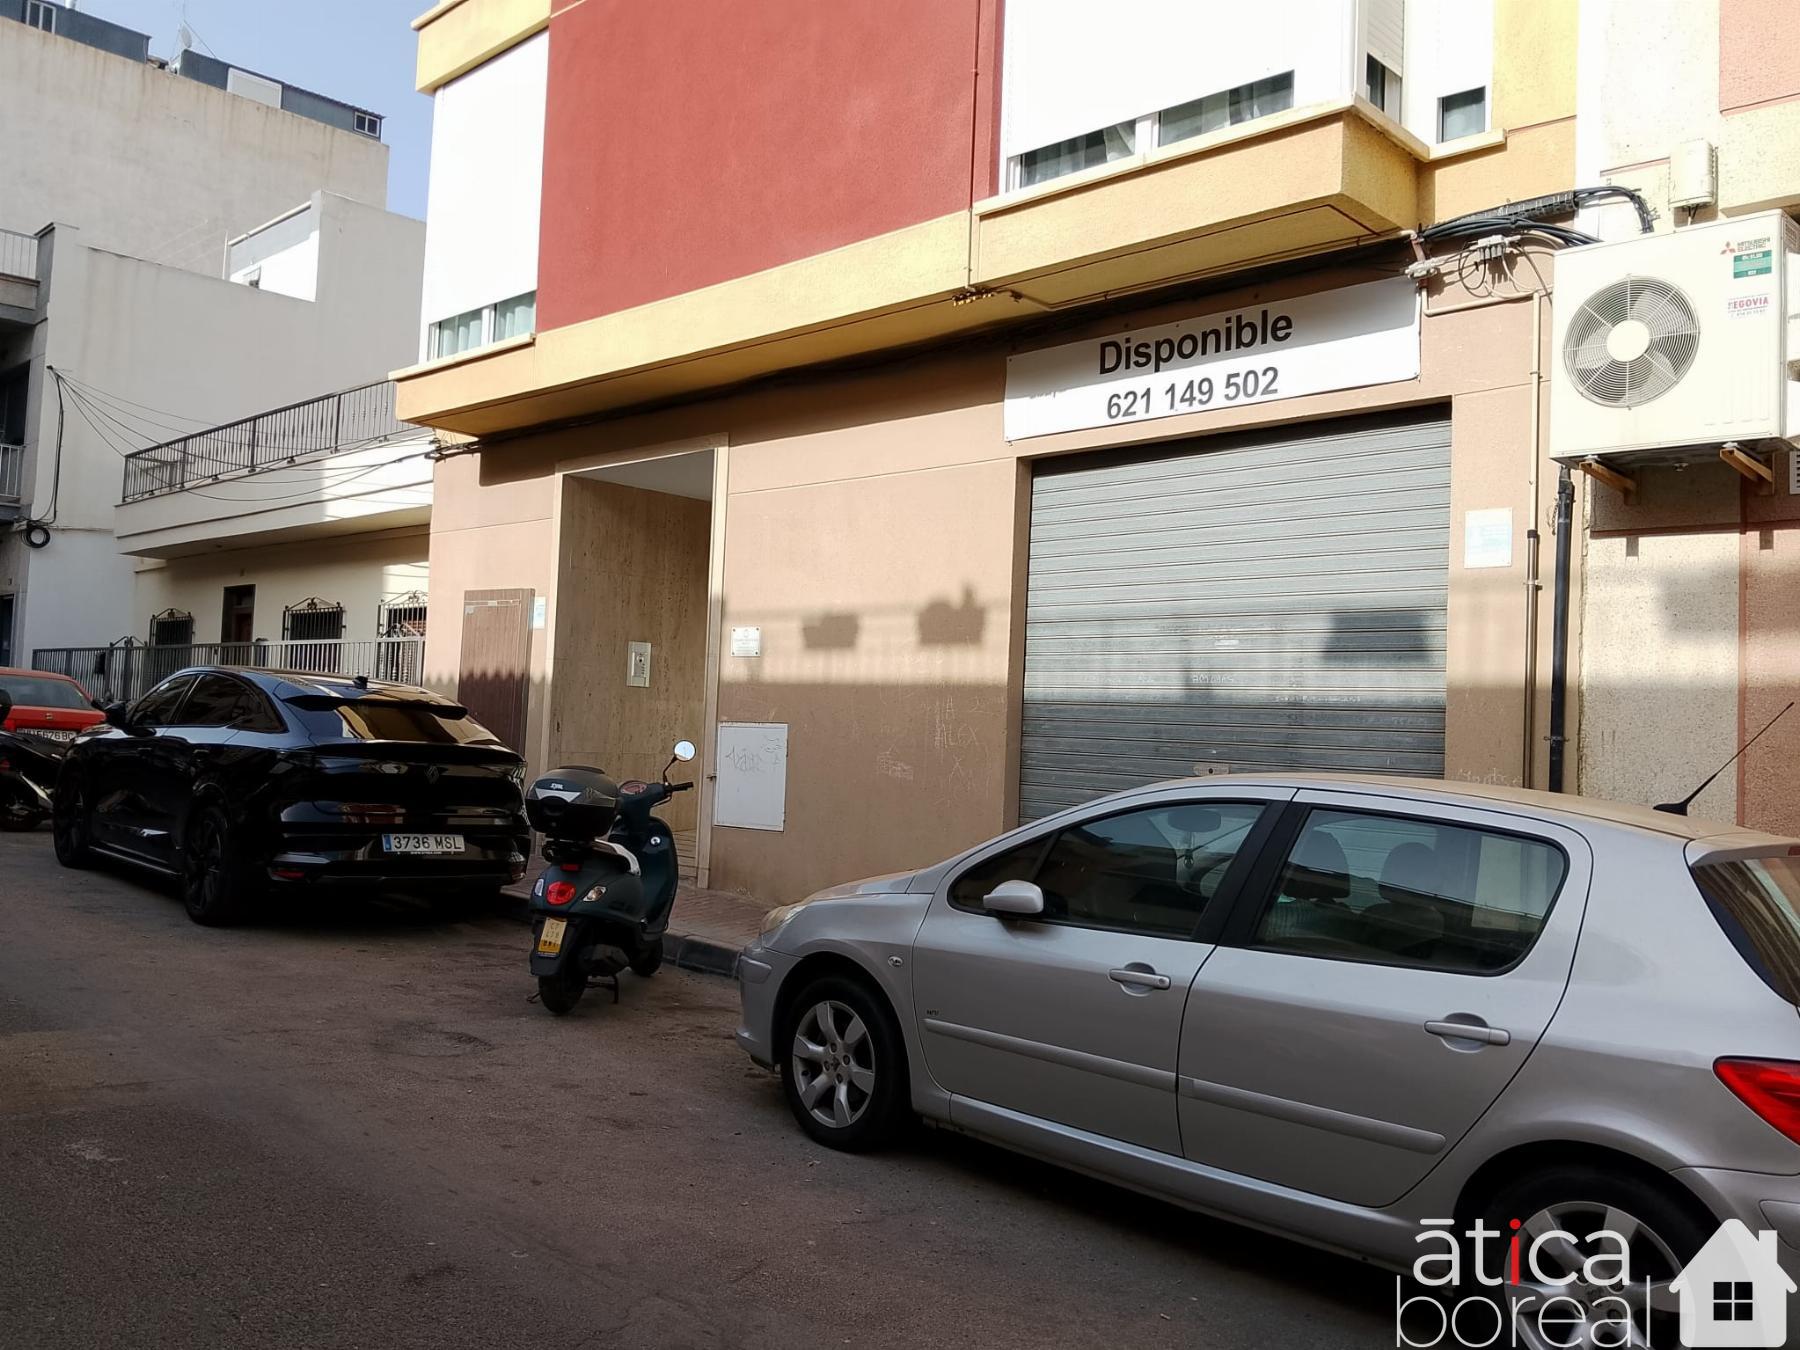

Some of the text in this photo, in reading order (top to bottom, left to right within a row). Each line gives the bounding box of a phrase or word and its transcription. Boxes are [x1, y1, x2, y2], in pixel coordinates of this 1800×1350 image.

[1099, 309, 1293, 375] Disponible
[1107, 366, 1279, 419] 621 149 502
[393, 836, 462, 849] 3736 MSL
